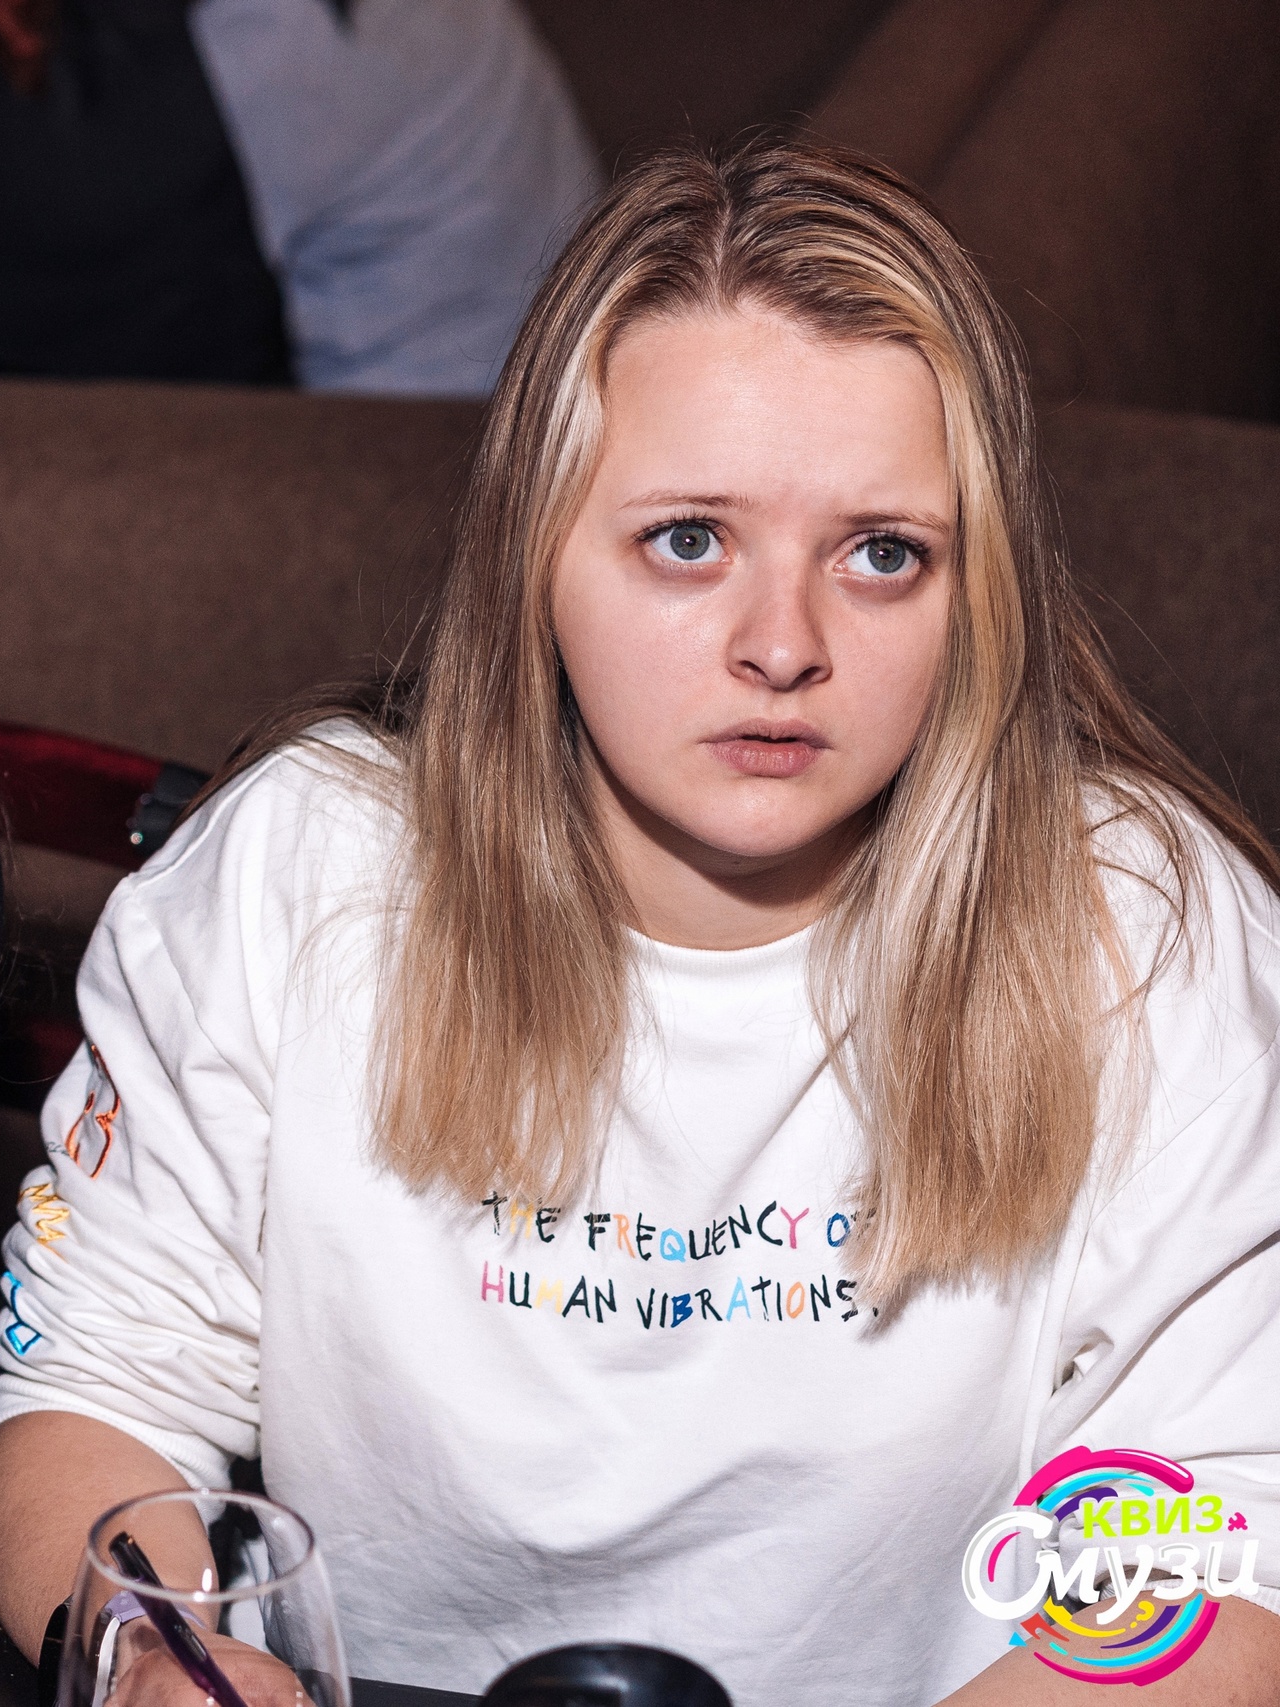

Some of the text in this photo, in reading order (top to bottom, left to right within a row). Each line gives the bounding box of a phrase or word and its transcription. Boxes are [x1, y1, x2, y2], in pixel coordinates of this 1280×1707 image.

[482, 1190, 561, 1243] THE
[583, 1200, 810, 1262] FREQUENCY
[481, 1260, 617, 1323] HUMAN
